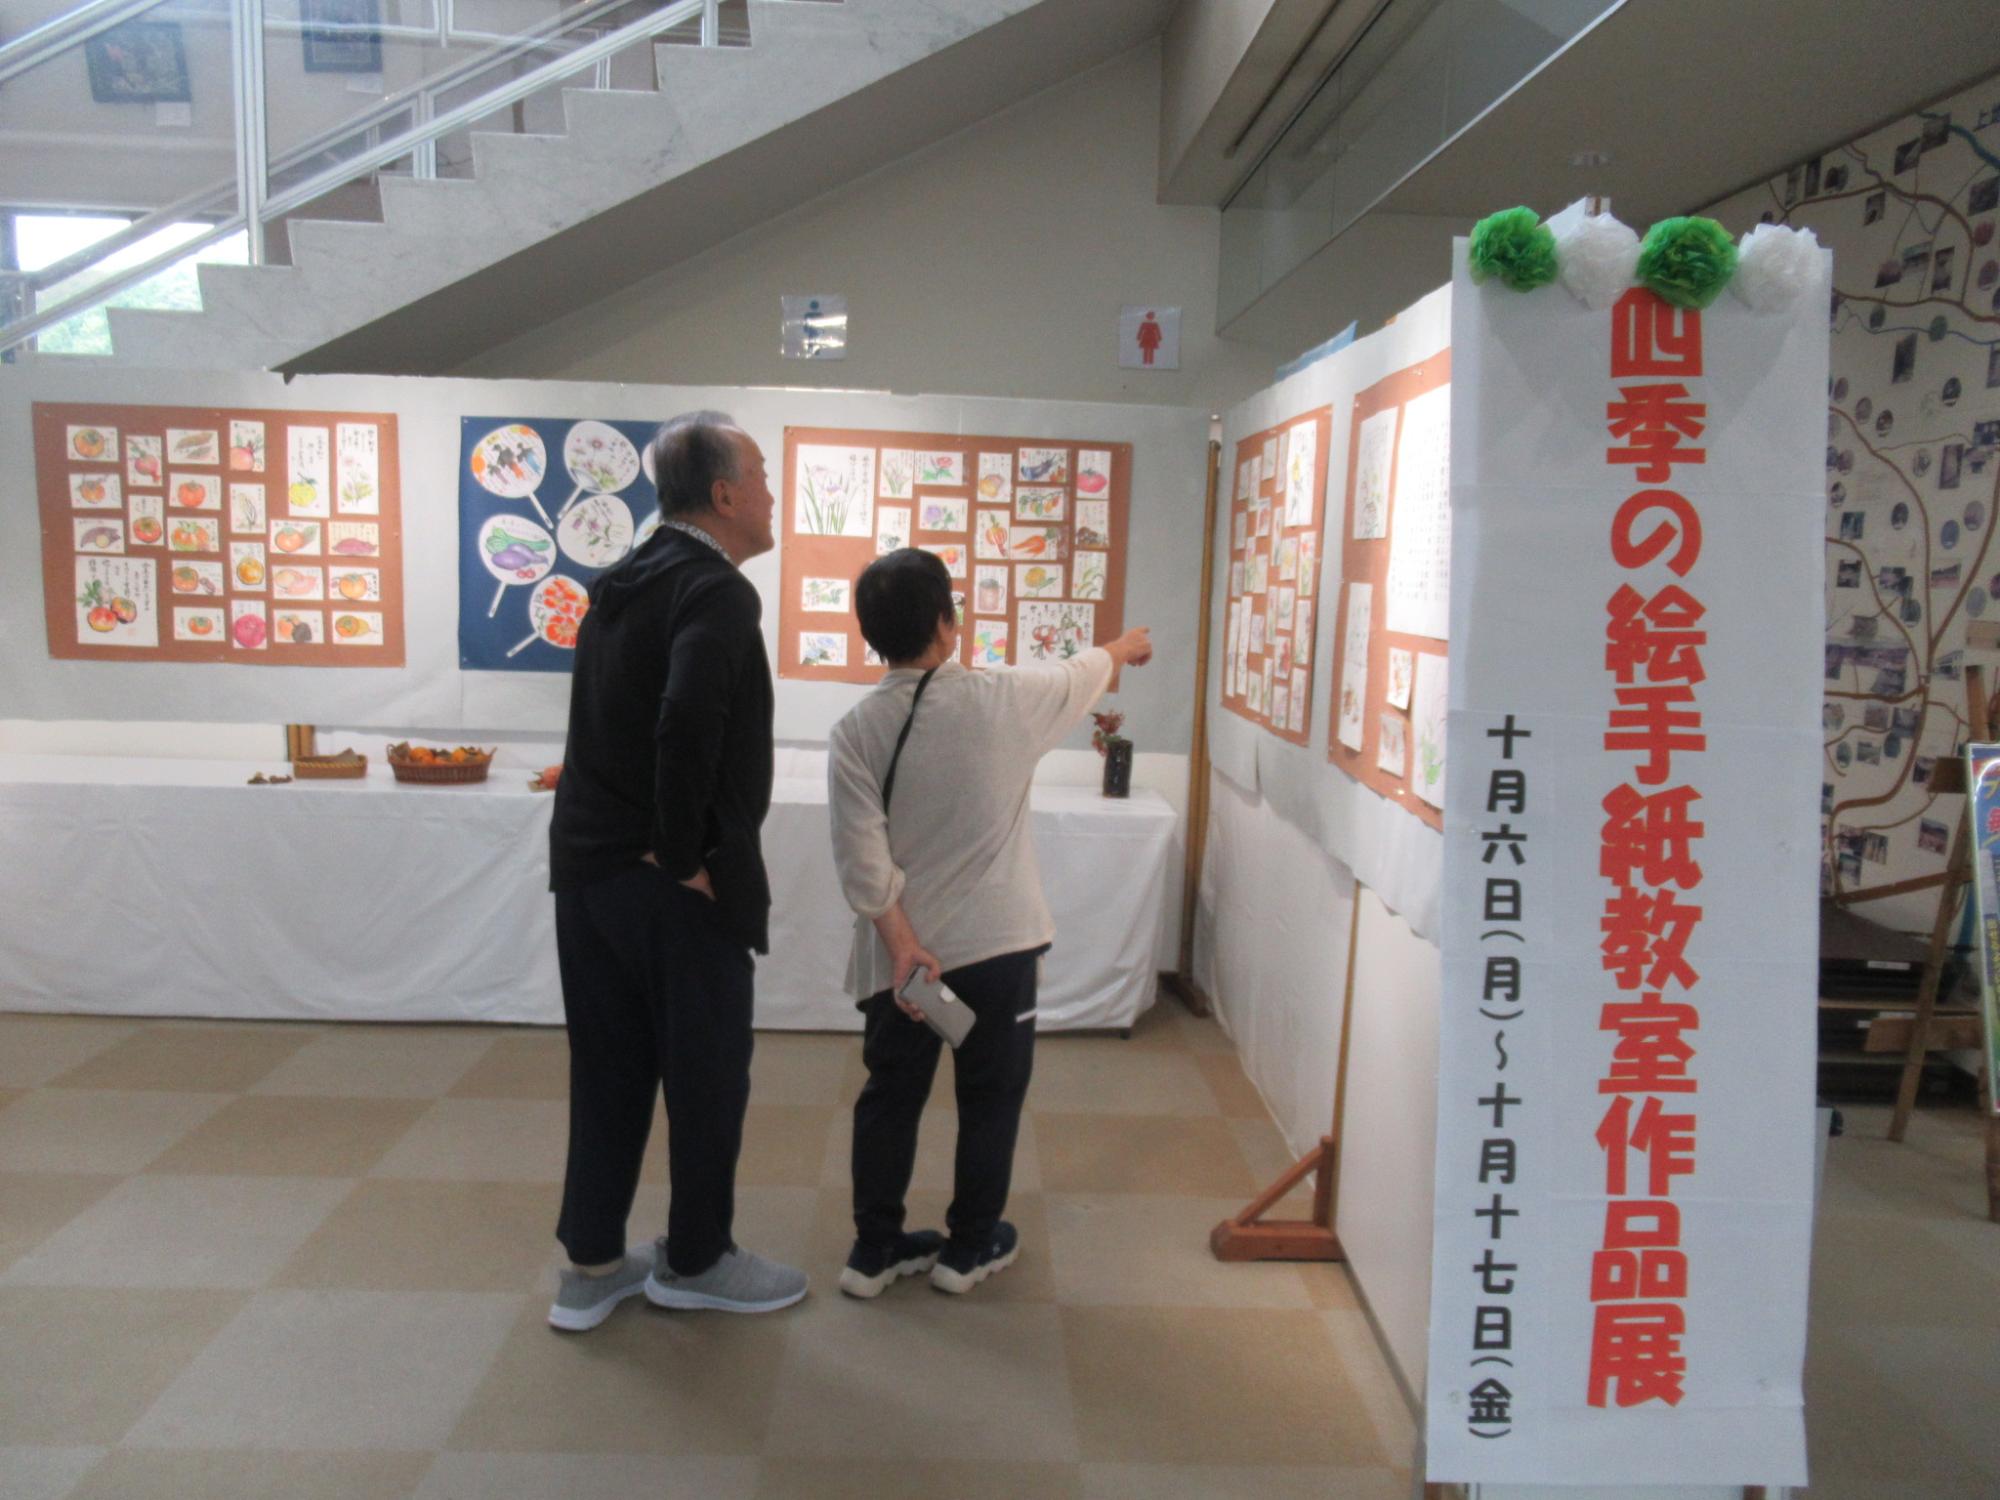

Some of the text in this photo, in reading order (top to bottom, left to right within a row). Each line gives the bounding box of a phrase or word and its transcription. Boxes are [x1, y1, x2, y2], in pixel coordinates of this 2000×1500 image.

[1587, 287, 1706, 1408] 四季の絵手紙教室作品展
